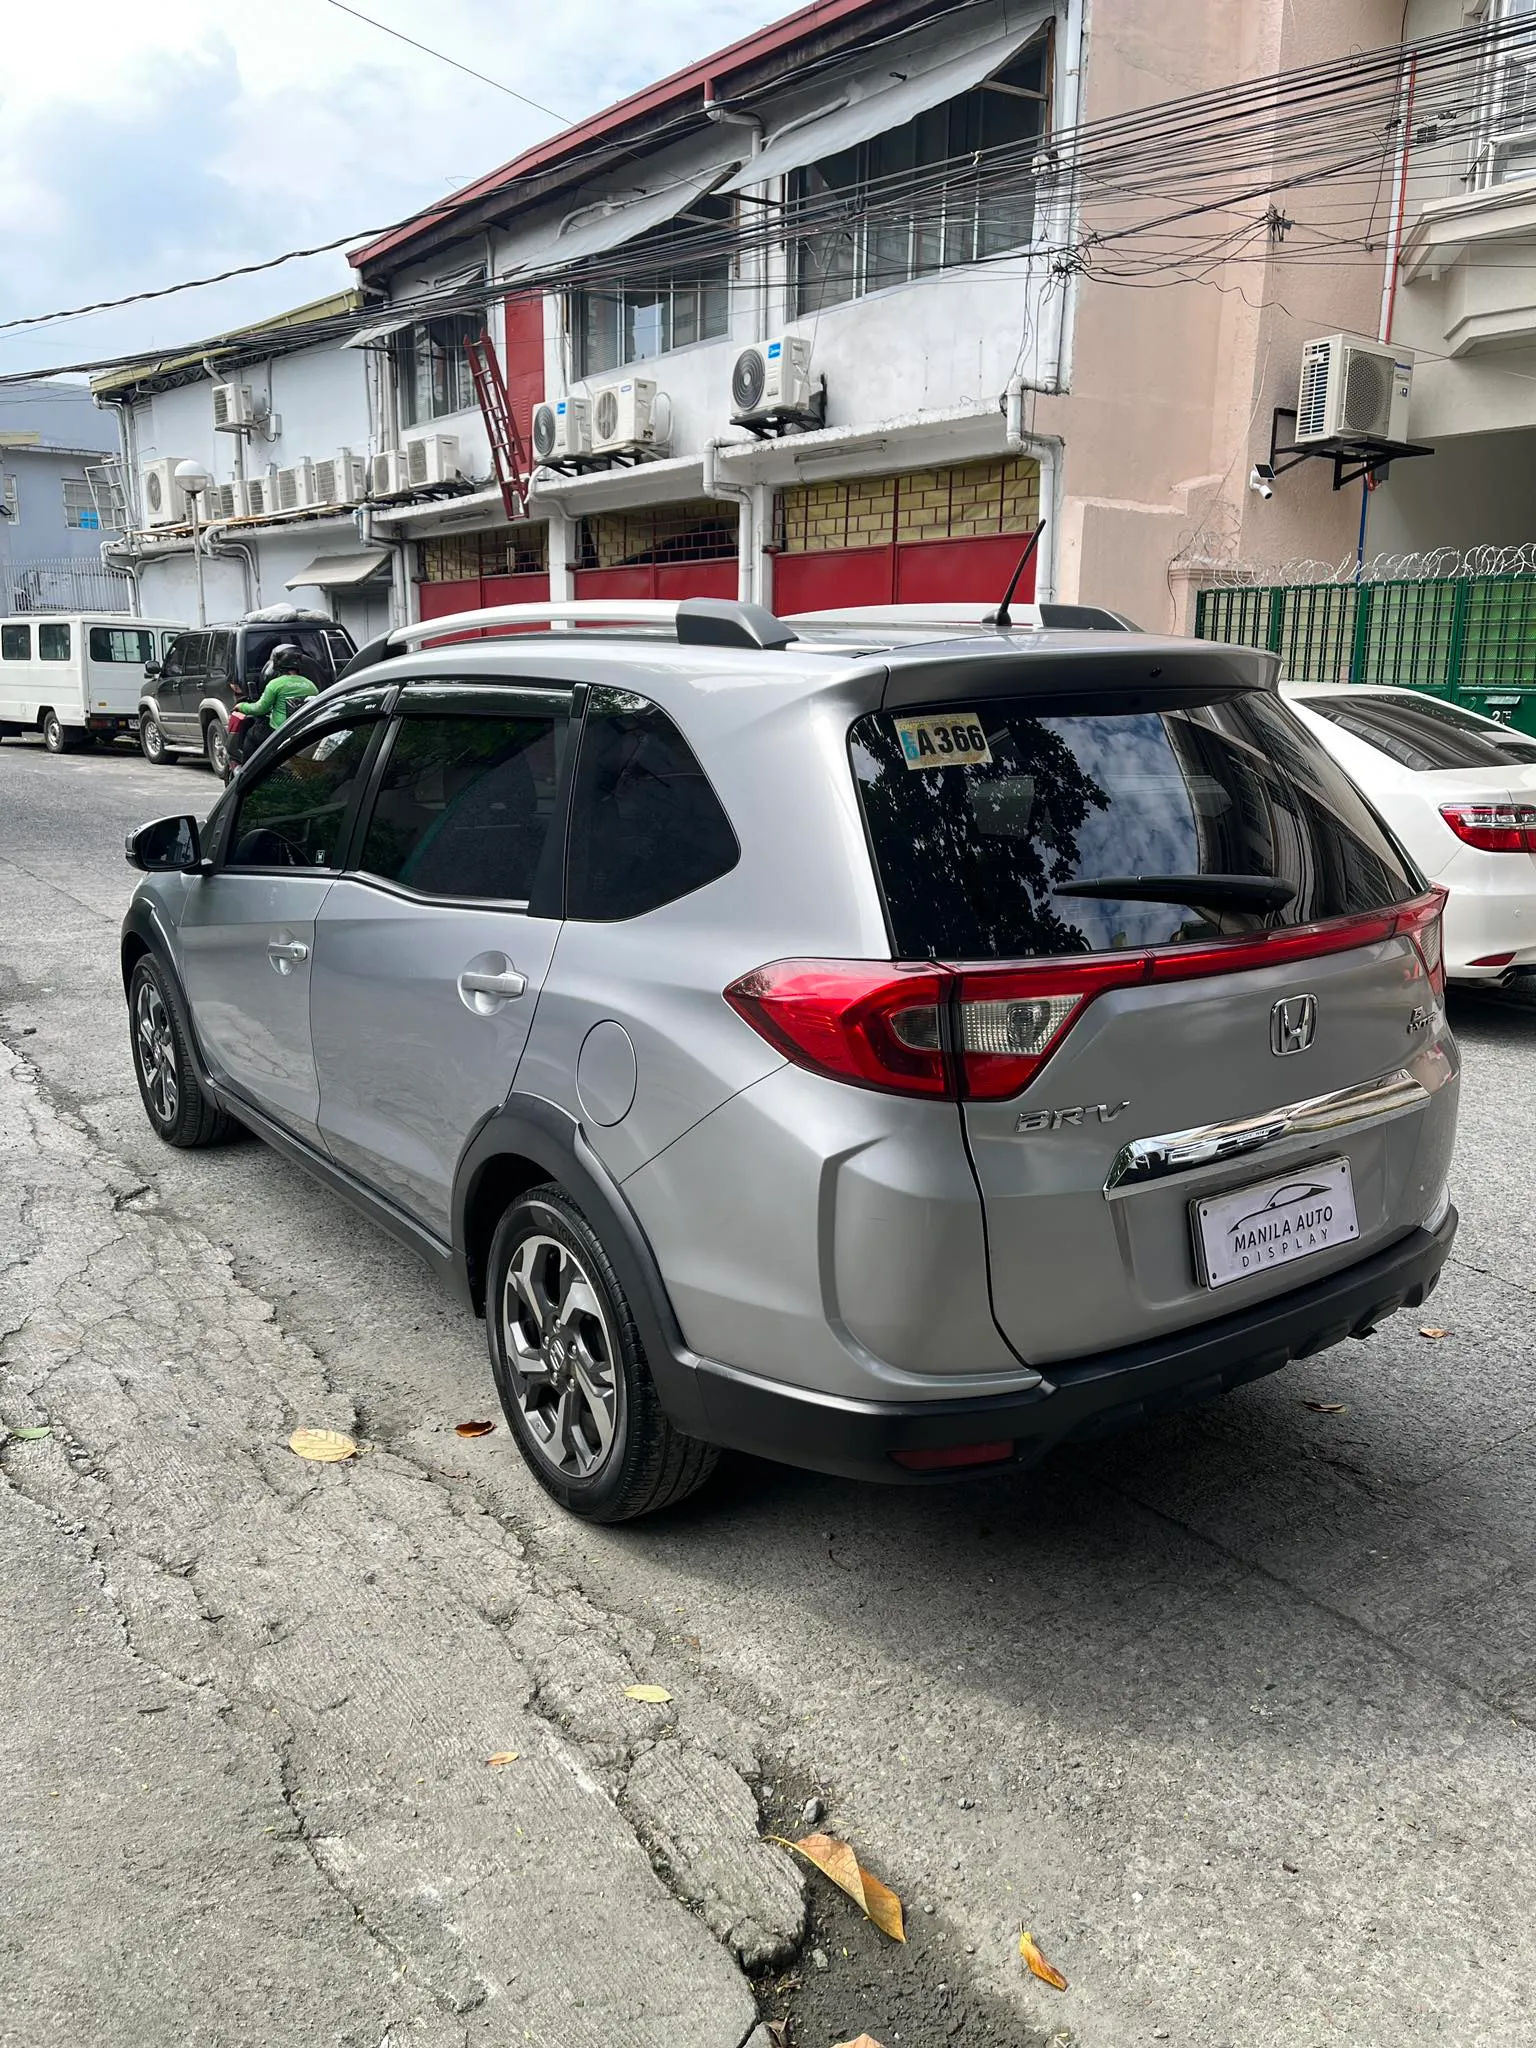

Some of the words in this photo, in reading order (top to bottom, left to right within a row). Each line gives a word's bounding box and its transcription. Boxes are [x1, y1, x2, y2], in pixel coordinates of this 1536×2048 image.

[916, 724, 986, 756] A366
[1234, 1219, 1292, 1253] MANILA
[1296, 1205, 1333, 1233] AUTO
[1242, 1229, 1329, 1268] DISPLAY
